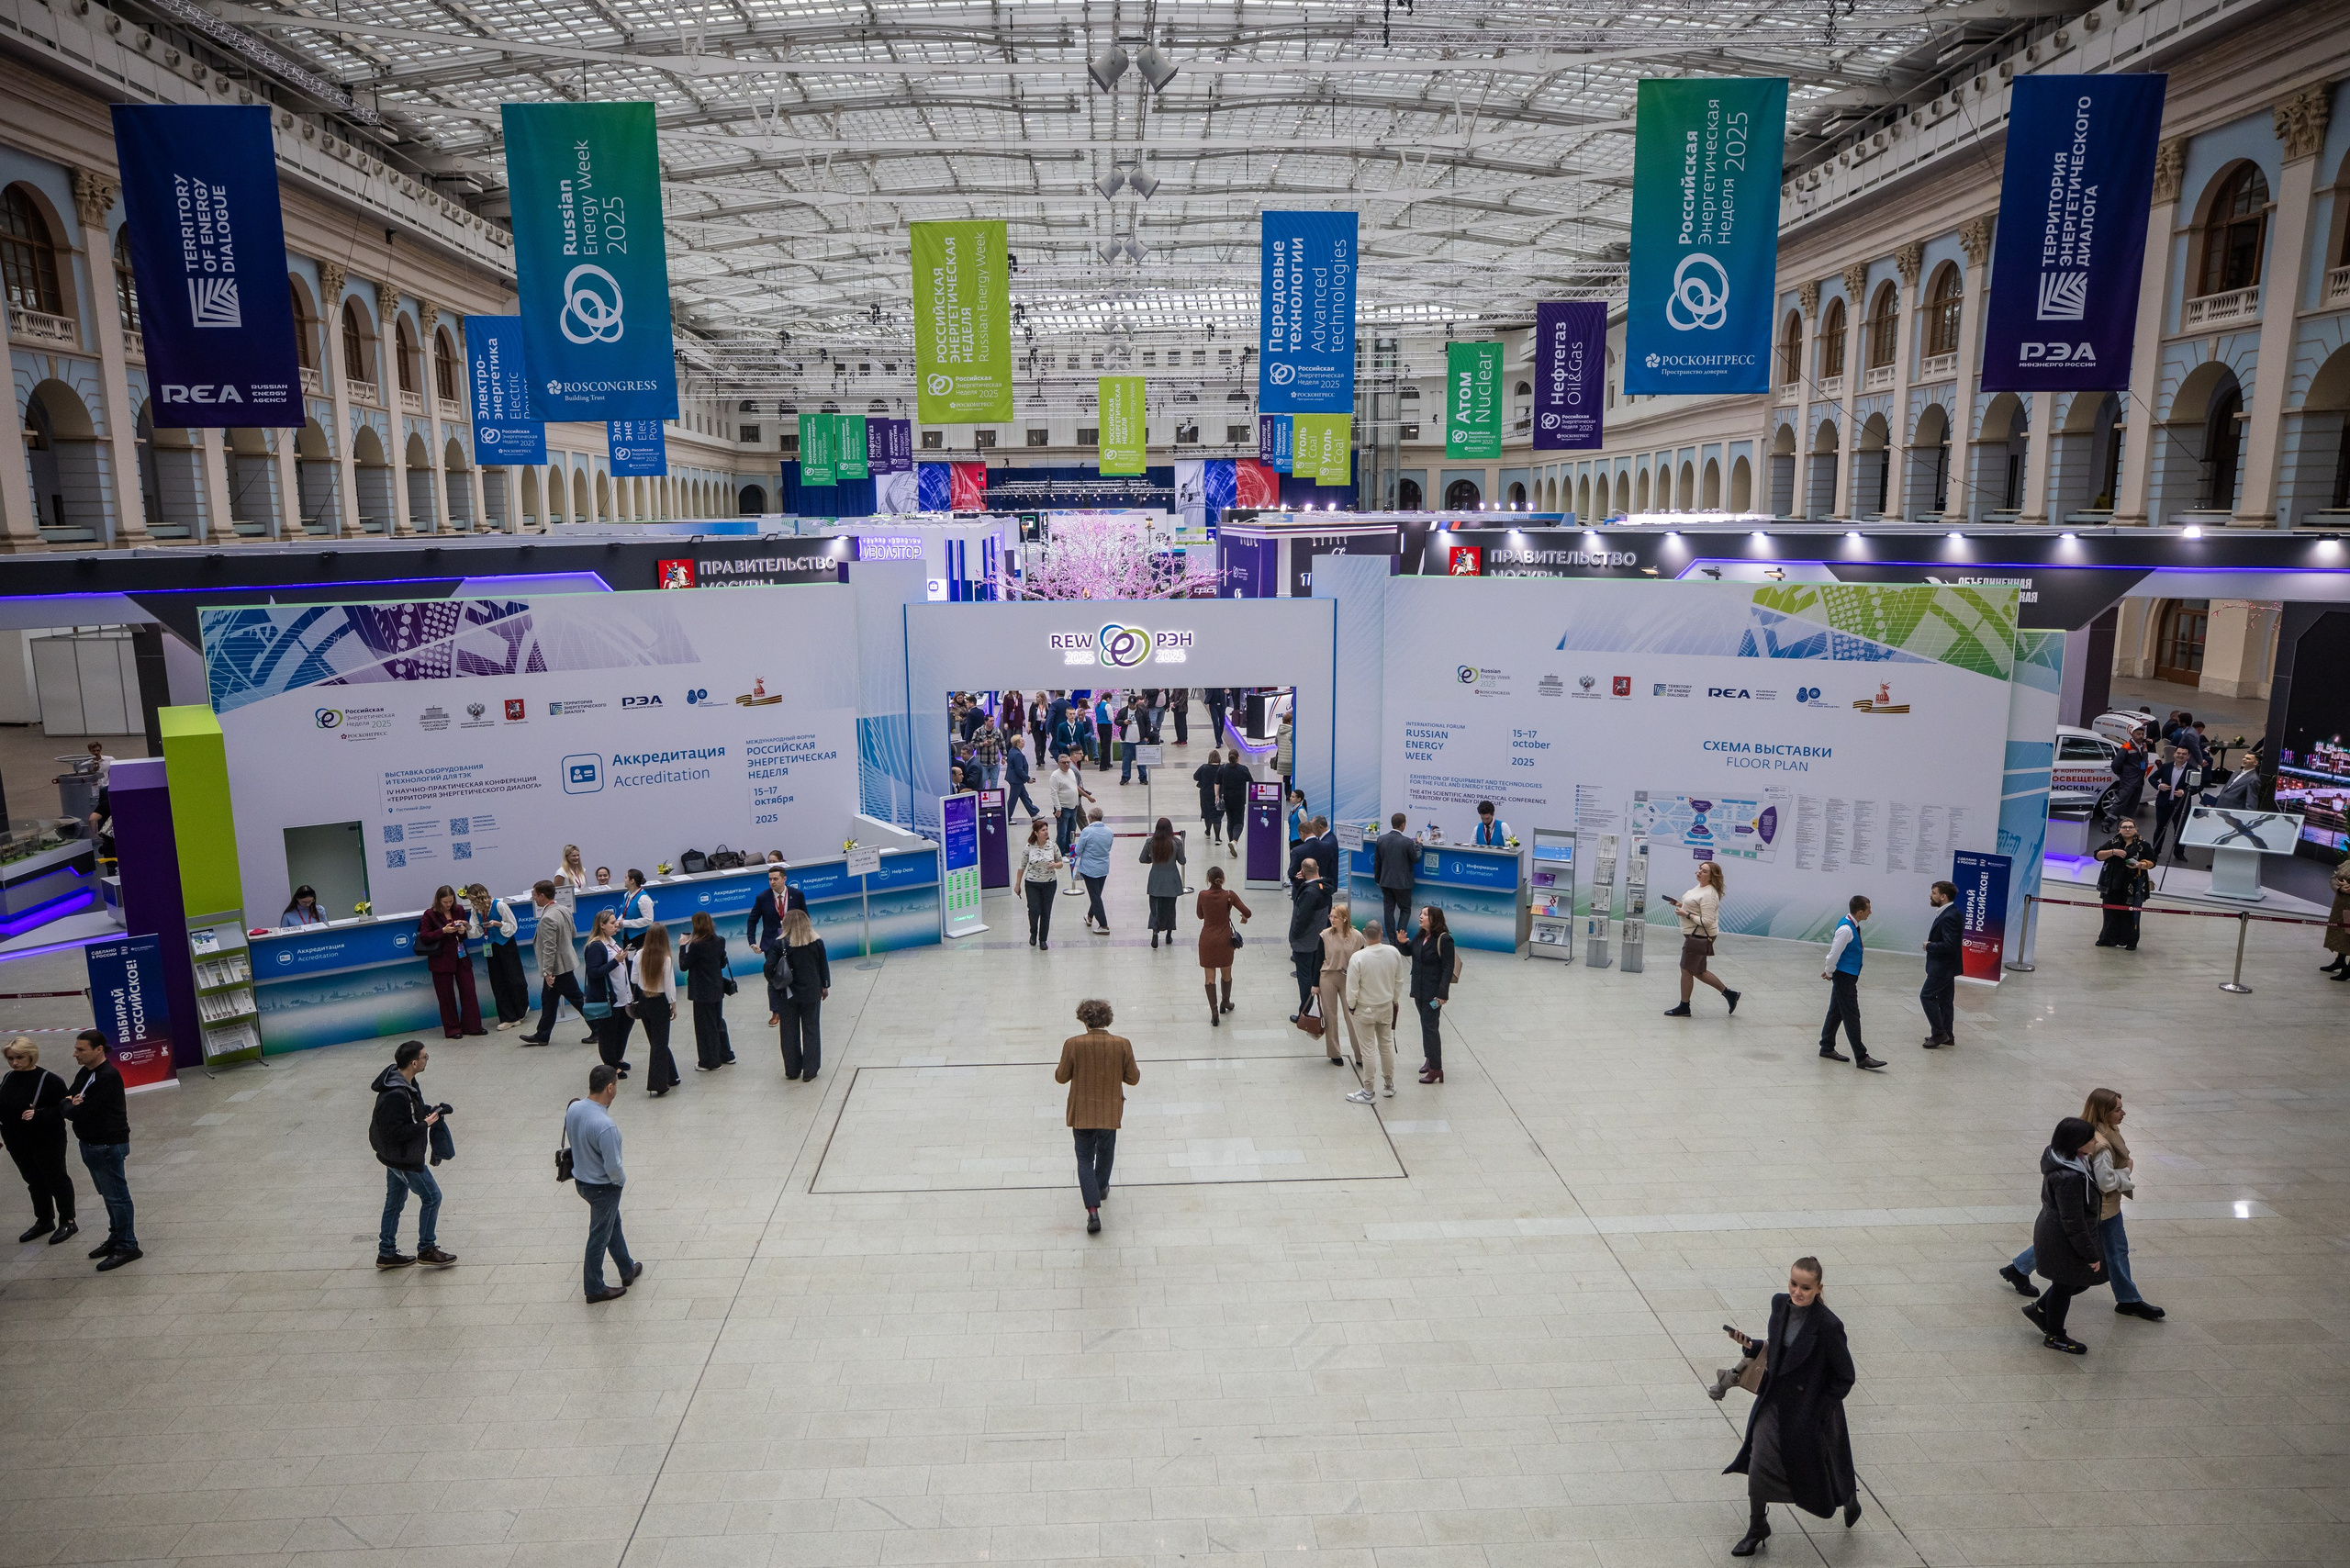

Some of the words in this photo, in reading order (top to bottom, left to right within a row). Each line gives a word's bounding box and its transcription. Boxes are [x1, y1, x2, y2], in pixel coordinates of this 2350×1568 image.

[1725, 112, 1748, 172] 2025
[574, 140, 592, 190] Week
[1698, 99, 1720, 245] Энергетическая
[1679, 130, 1698, 245] Российская
[2059, 95, 2092, 267] ЭНЕРГЕТИЧЕСКОГО
[193, 177, 214, 244] ENERGY
[557, 179, 577, 255] Russian
[1718, 178, 1735, 244] Неделя
[2042, 151, 2067, 267] ТЕРРИТОРИЯ
[173, 174, 199, 273] TERRITORY
[212, 185, 235, 273] DIALOGUE
[582, 196, 599, 255] Energy
[602, 196, 627, 254] 2025
[2076, 185, 2098, 267] ДИАЛОГА
[974, 232, 986, 266] Week
[203, 250, 218, 273] OF
[976, 268, 990, 310] Energy
[1269, 241, 1286, 352] Передовые
[1290, 237, 1304, 353] технологии
[1330, 239, 1350, 353] technologies
[946, 237, 961, 363] ЭНЕРГЕТИЧЕСКАЯ
[1311, 267, 1326, 353] Advanced
[932, 267, 946, 363] РОССИЙСКАЯ
[962, 308, 974, 363] НЕДЕЛЯ
[978, 314, 990, 362] Russian
[1662, 354, 1755, 365] РОСКОНГРЕСС
[2020, 342, 2097, 361] РЭА
[1550, 321, 1568, 405] Нефтегаз
[1568, 342, 1583, 405] Oil&Gas
[476, 354, 489, 420] Электро-
[488, 338, 504, 420] энергетика
[564, 380, 657, 393] ROSCONGRESS
[1321, 379, 1340, 388] 2025
[1475, 351, 1492, 422] Nuclear
[161, 385, 243, 403] REA
[507, 372, 521, 420] Electric
[1298, 427, 1307, 458] Уголь
[1308, 436, 1317, 458] Coal
[1322, 429, 1332, 464] Уголь
[1334, 439, 1344, 464] Coal
[863, 545, 922, 559] ИЗОЛЯТОР
[1490, 549, 1637, 566] ПРАВИТЕЛЬСТВО
[699, 555, 837, 576] ПРАВИТЕЛЬСТВО
[1051, 634, 1093, 648] REW
[1156, 633, 1192, 646] РЭН
[1065, 652, 1094, 664] 2025
[1155, 650, 1186, 662] 2025
[621, 695, 663, 707] РЭА
[1708, 688, 1751, 700] REA
[346, 712, 395, 722] Энергетическая
[372, 720, 392, 729] 2025
[745, 734, 796, 745] МЕЖДУНАРОДНЫЙ
[1406, 729, 1449, 739] RUSSIAN
[1513, 739, 1550, 749] october
[746, 741, 816, 756] РОССИЙСКАЯ
[1405, 740, 1444, 750] ENERGY
[1703, 740, 1751, 755] СХЕМА
[1754, 743, 1833, 758] ВЫСТАВКИ
[612, 746, 725, 767] Аккредитация
[747, 751, 837, 767] ЭНЕРГЕТИЧЕСКАЯ
[1405, 751, 1433, 761] WEEK
[1511, 757, 1535, 767] 2025
[1726, 756, 1771, 769] FLOOR
[1774, 758, 1809, 772] PLAN
[385, 769, 424, 778] ВЫСТАВКА
[425, 764, 484, 775] ОБОРУДОВАНИЯ
[391, 774, 442, 785] ТЕХНОЛОГИЙ
[613, 767, 711, 788] Accreditation
[748, 767, 789, 779] НЕДЕЛЯ
[387, 792, 437, 803] «ТЕРРИТОРИЯ
[439, 787, 506, 798] ЭНЕРГЕТИЧЕСКОГО
[506, 783, 542, 792] ДИАЛОГА»
[395, 781, 484, 795] НАУЧНО-ПРАКТИЧЕСКАЯ
[485, 776, 537, 786] КОНФЕРЕНЦИЯ
[1498, 780, 1542, 789] TECHNOLOGIES
[755, 794, 794, 807] октября
[1409, 794, 1442, 802] "TERRITORY
[1450, 797, 1472, 805] ENERGY
[1508, 796, 1547, 805] CONFERENCE
[755, 813, 778, 823] 2025
[1466, 863, 1498, 871] Информация
[713, 887, 751, 896] Аккредитация
[714, 894, 745, 902] Accreditation
[1975, 871, 1988, 932] РОССИЙСКОЕ!
[1964, 890, 1975, 930] ВЫБИРАЙ
[297, 943, 345, 954] Аккредитация
[297, 952, 339, 962] Accreditation
[126, 959, 147, 1040] РОССИЙСКОЕ!
[111, 988, 130, 1043] ВЫБИРАЙ
